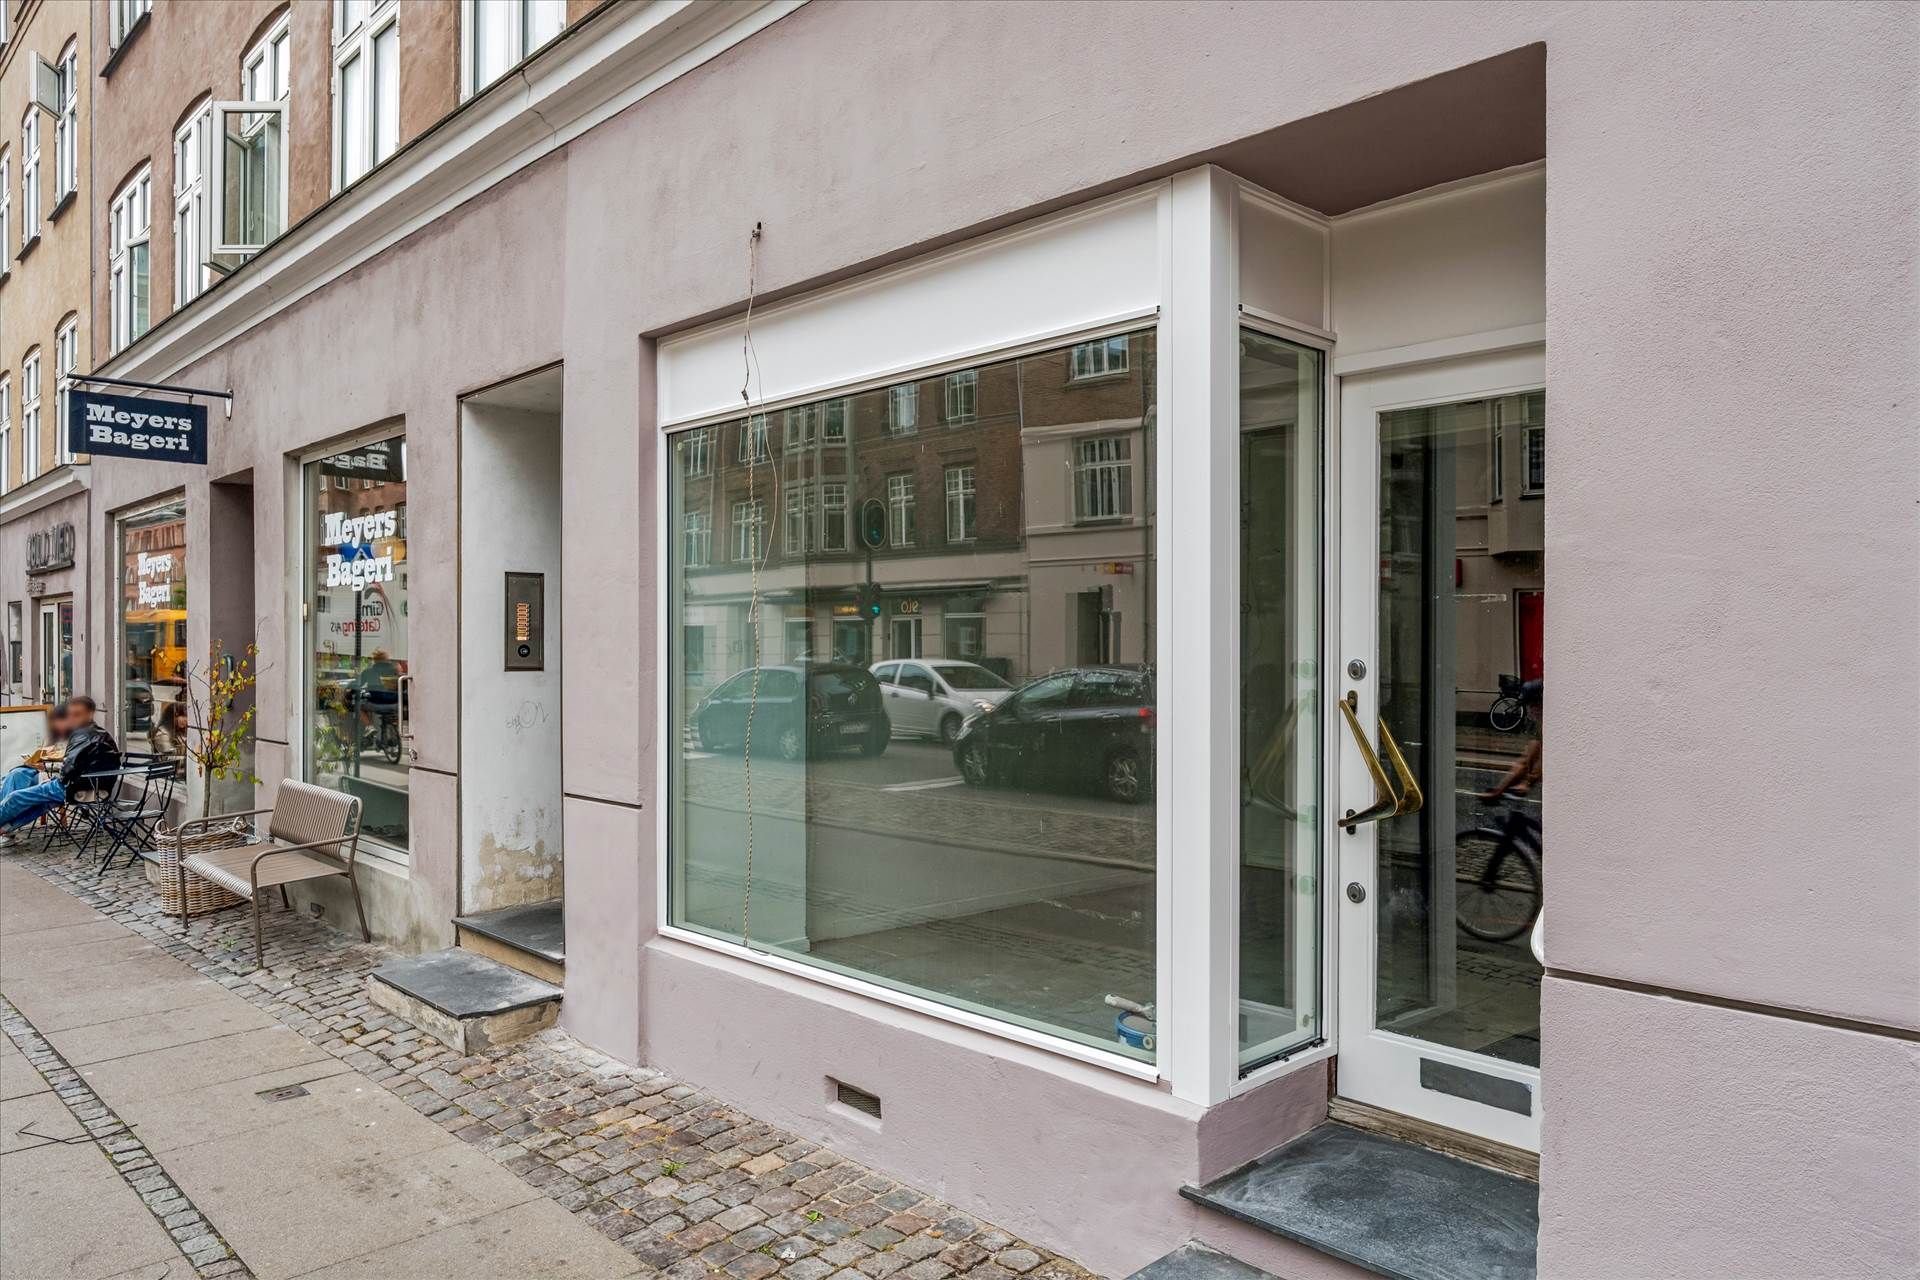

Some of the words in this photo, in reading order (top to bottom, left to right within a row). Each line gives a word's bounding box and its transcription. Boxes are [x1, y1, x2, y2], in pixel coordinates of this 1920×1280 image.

[86, 403, 192, 432] Meyers
[89, 424, 190, 451] Bageri
[324, 509, 397, 549] Meyers
[137, 551, 172, 579] Meyers
[326, 546, 394, 592] Bageri
[138, 578, 171, 608] Bageri
